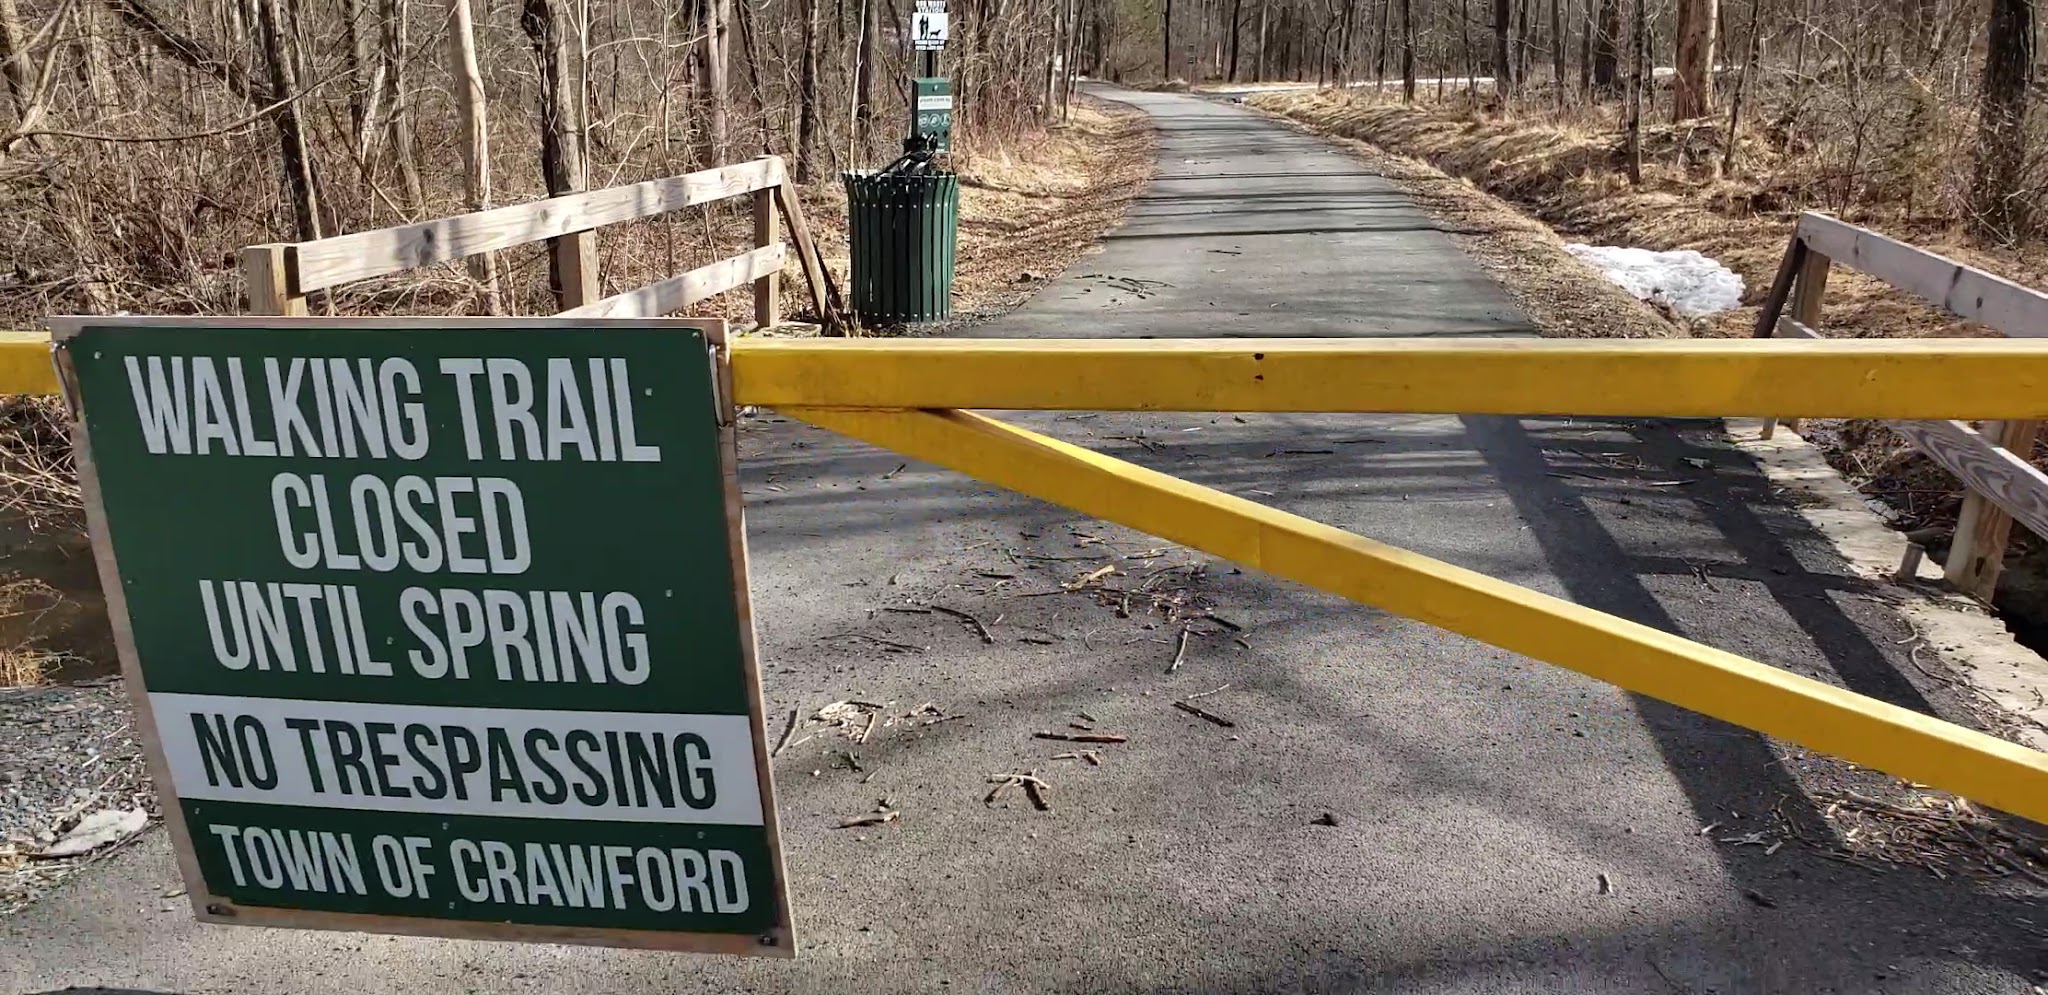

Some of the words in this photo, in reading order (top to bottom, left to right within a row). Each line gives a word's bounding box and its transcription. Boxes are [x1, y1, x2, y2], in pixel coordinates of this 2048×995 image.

[124, 355, 430, 462] WALKING
[440, 357, 661, 463] TRAIL
[272, 472, 532, 574] CLOSED
[199, 580, 393, 677] UNTIL
[399, 587, 651, 686] SPRING
[191, 713, 278, 791] NO
[286, 718, 717, 810] TRESPASSING
[210, 824, 367, 896] TOWN
[371, 834, 435, 900] OF
[450, 840, 749, 914] CRAWFORD
